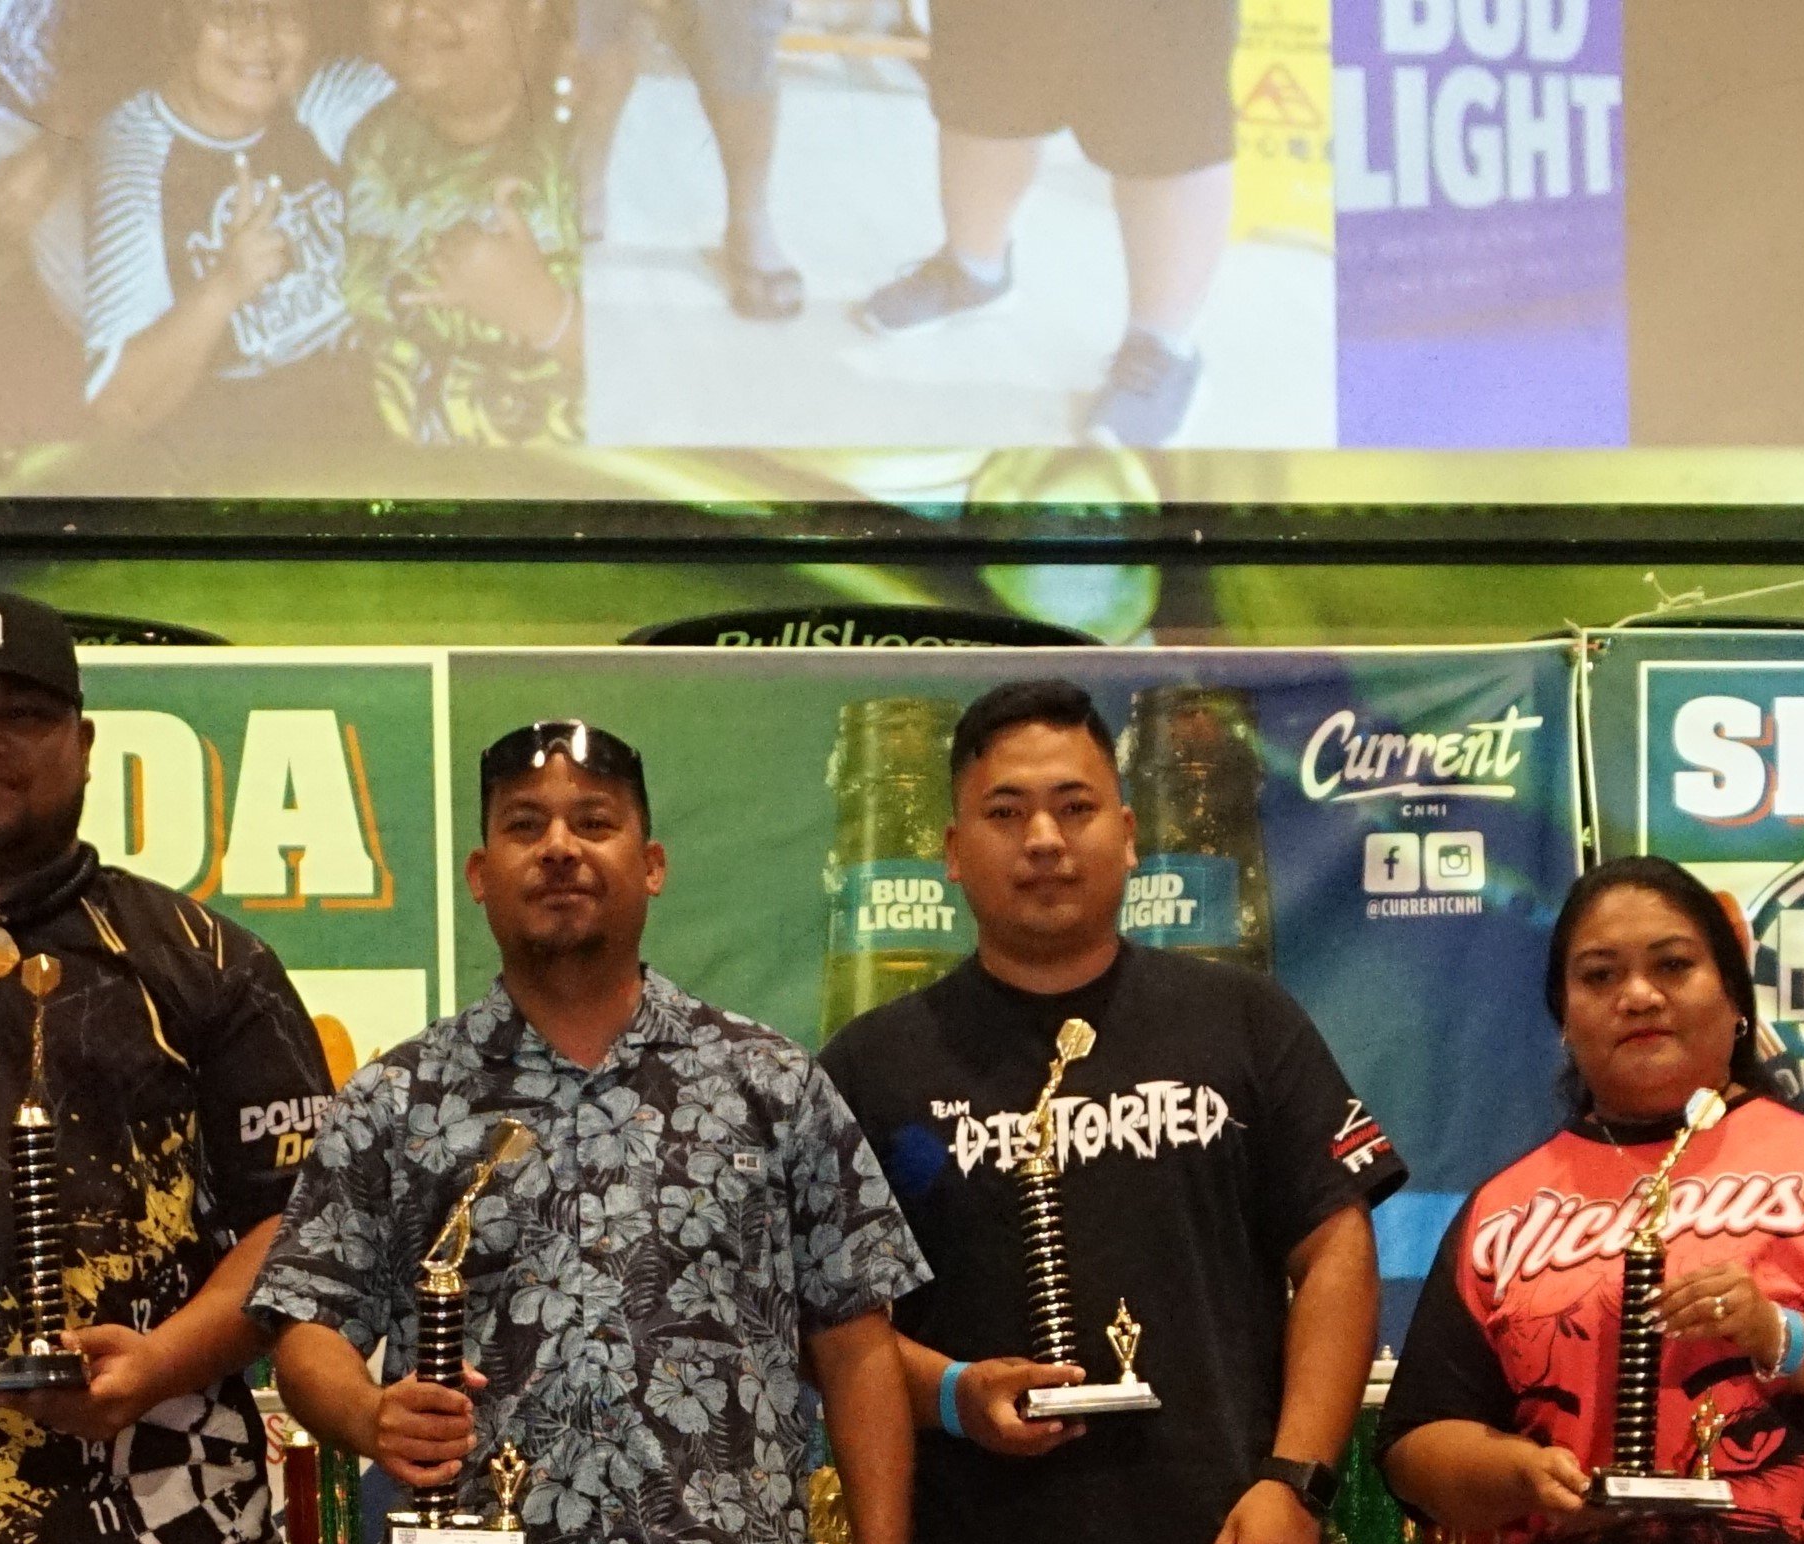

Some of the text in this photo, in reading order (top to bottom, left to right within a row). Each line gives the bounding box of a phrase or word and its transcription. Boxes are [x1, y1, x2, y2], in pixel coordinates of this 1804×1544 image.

[1331, 65, 1623, 212] LIGHT
[1301, 704, 1544, 799] Current
[1401, 804, 1448, 817] CNMI
[870, 878, 945, 904] BUD
[1128, 873, 1185, 900] BUD
[857, 904, 957, 931] LIGHT
[1366, 896, 1483, 919] @CURRENTCNMI
[930, 1100, 971, 1119] TEAM
